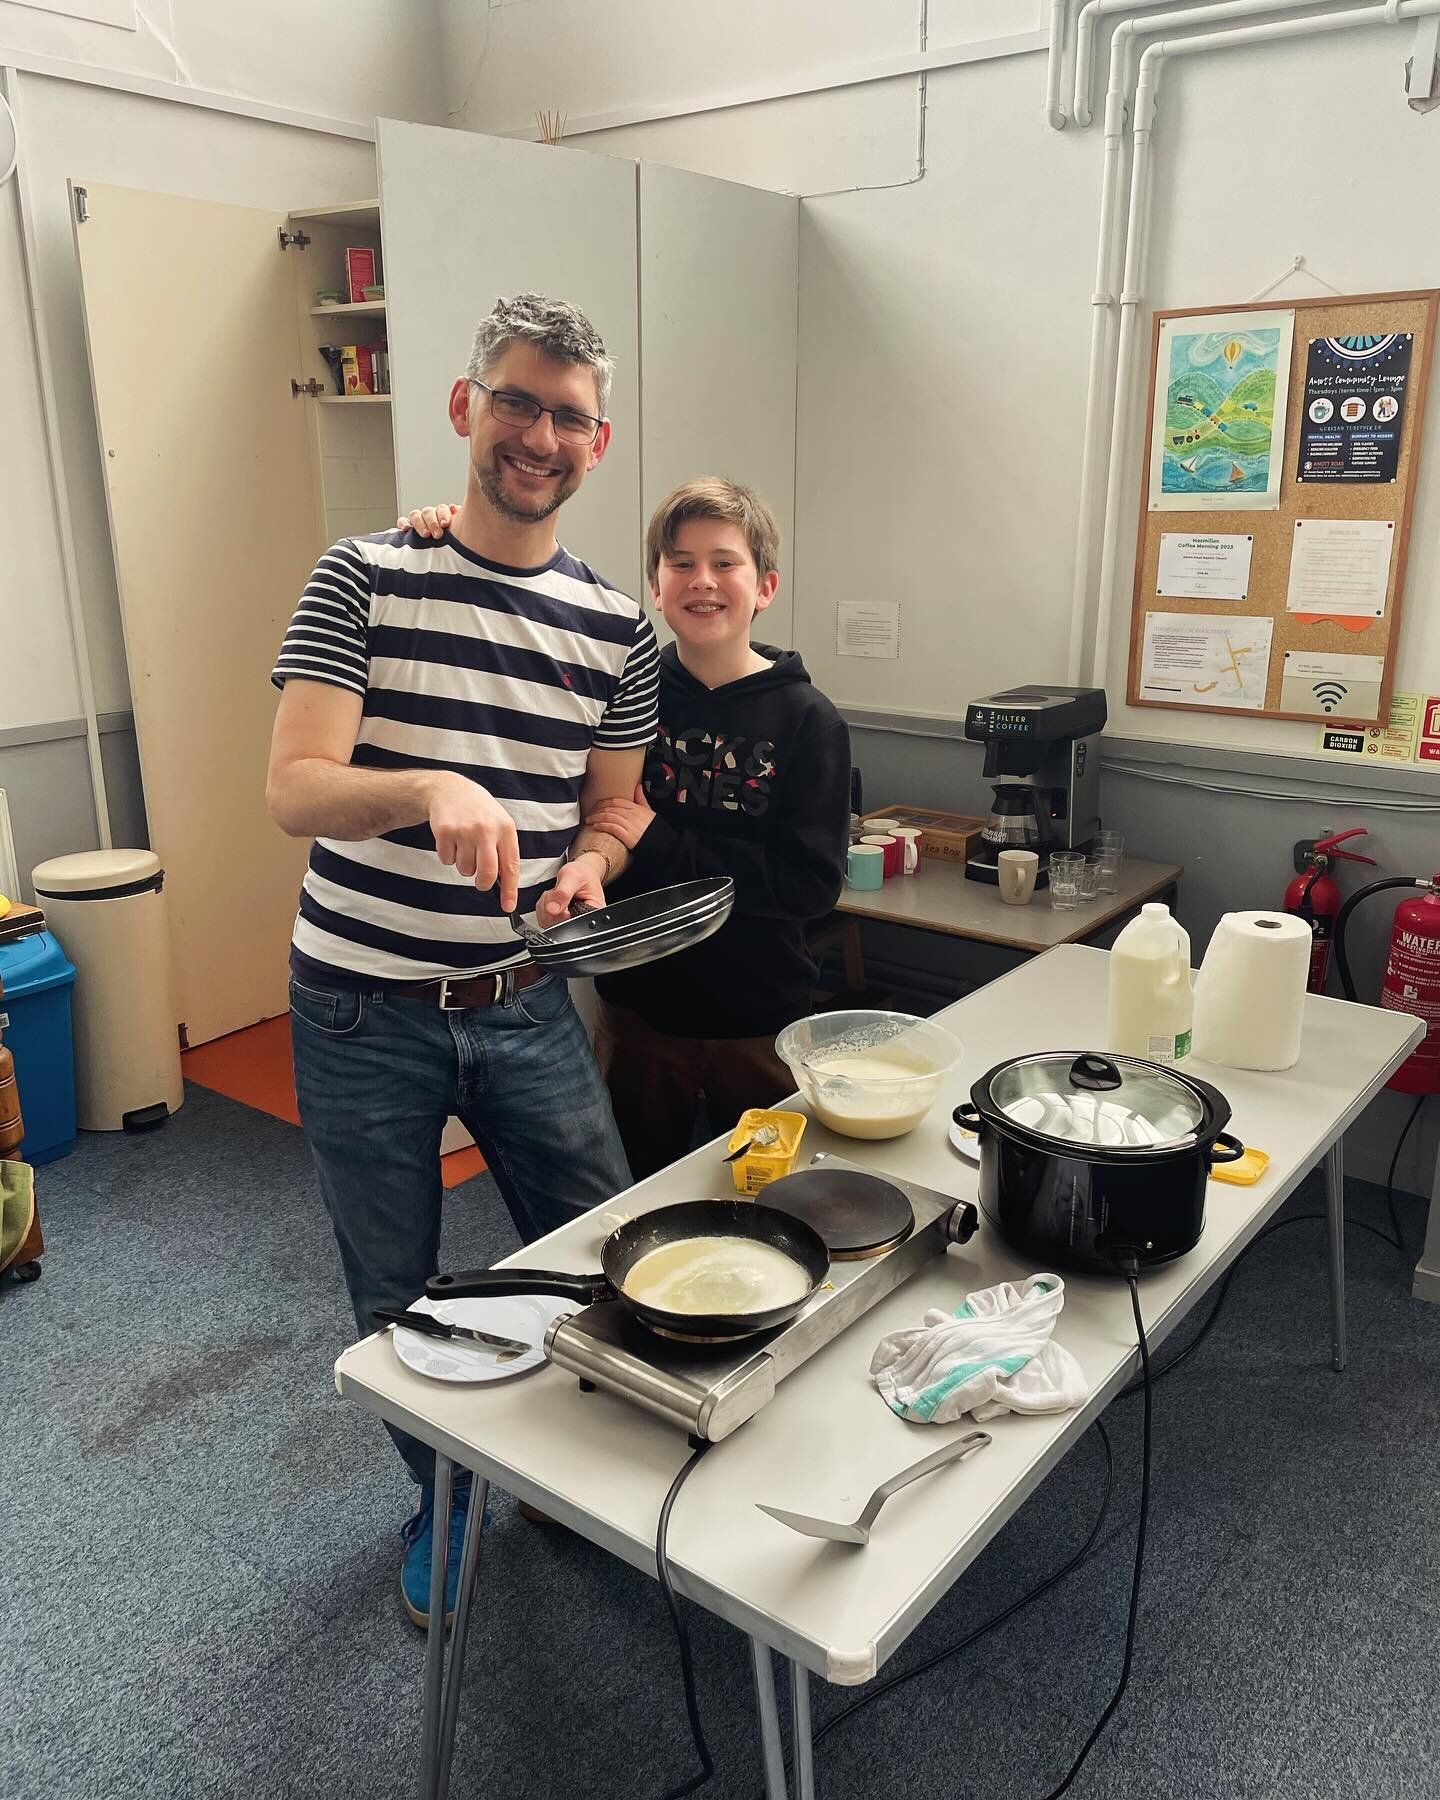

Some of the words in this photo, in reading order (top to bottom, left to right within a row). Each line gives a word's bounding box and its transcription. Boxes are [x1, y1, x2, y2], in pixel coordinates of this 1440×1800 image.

[1335, 375, 1377, 387] Community
[1378, 374, 1405, 387] Lounge
[1308, 387, 1338, 395] Thursdays
[996, 714, 1026, 723] FILTER
[996, 722, 1030, 731] COFFEE
[1330, 735, 1358, 744] CARBON
[1329, 742, 1358, 750] DIOXIDE
[926, 844, 940, 854] Tea
[943, 846, 961, 856] Box
[1396, 939, 1406, 948] FIRE
